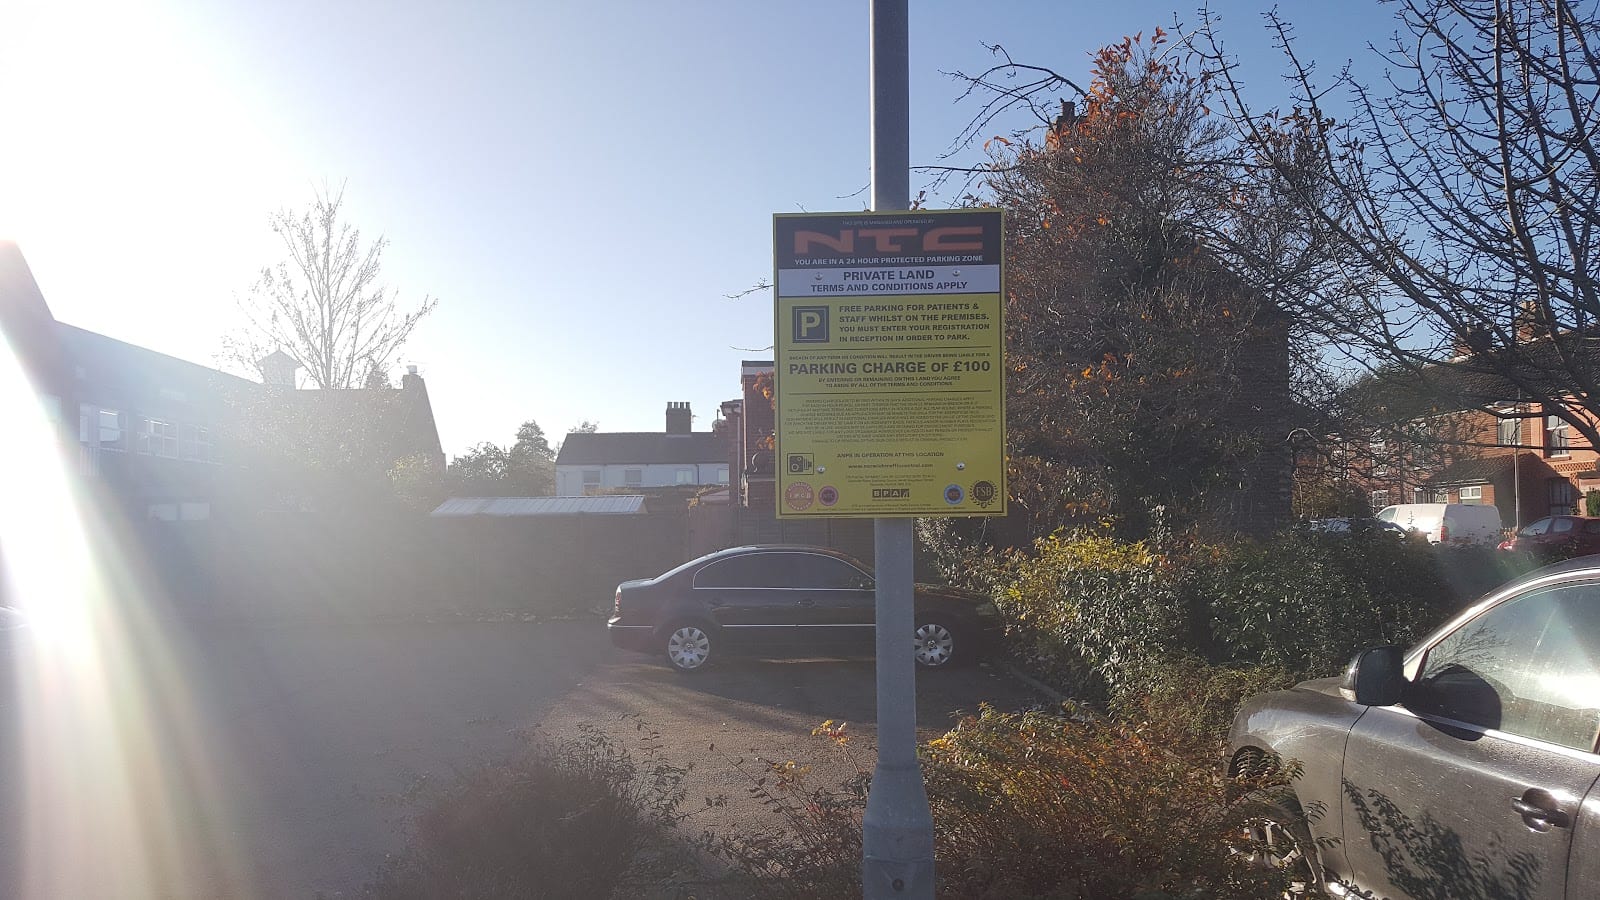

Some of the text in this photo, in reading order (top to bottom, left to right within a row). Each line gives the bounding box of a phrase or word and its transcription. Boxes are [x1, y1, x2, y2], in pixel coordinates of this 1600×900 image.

[795, 226, 983, 254] NTC
[844, 270, 934, 281] PRIVATE LAND
[811, 284, 844, 292] TERMS
[872, 282, 934, 291] CONDITIONS
[802, 312, 820, 337] P
[789, 361, 990, 374] PARKING CHARGE OF £100
